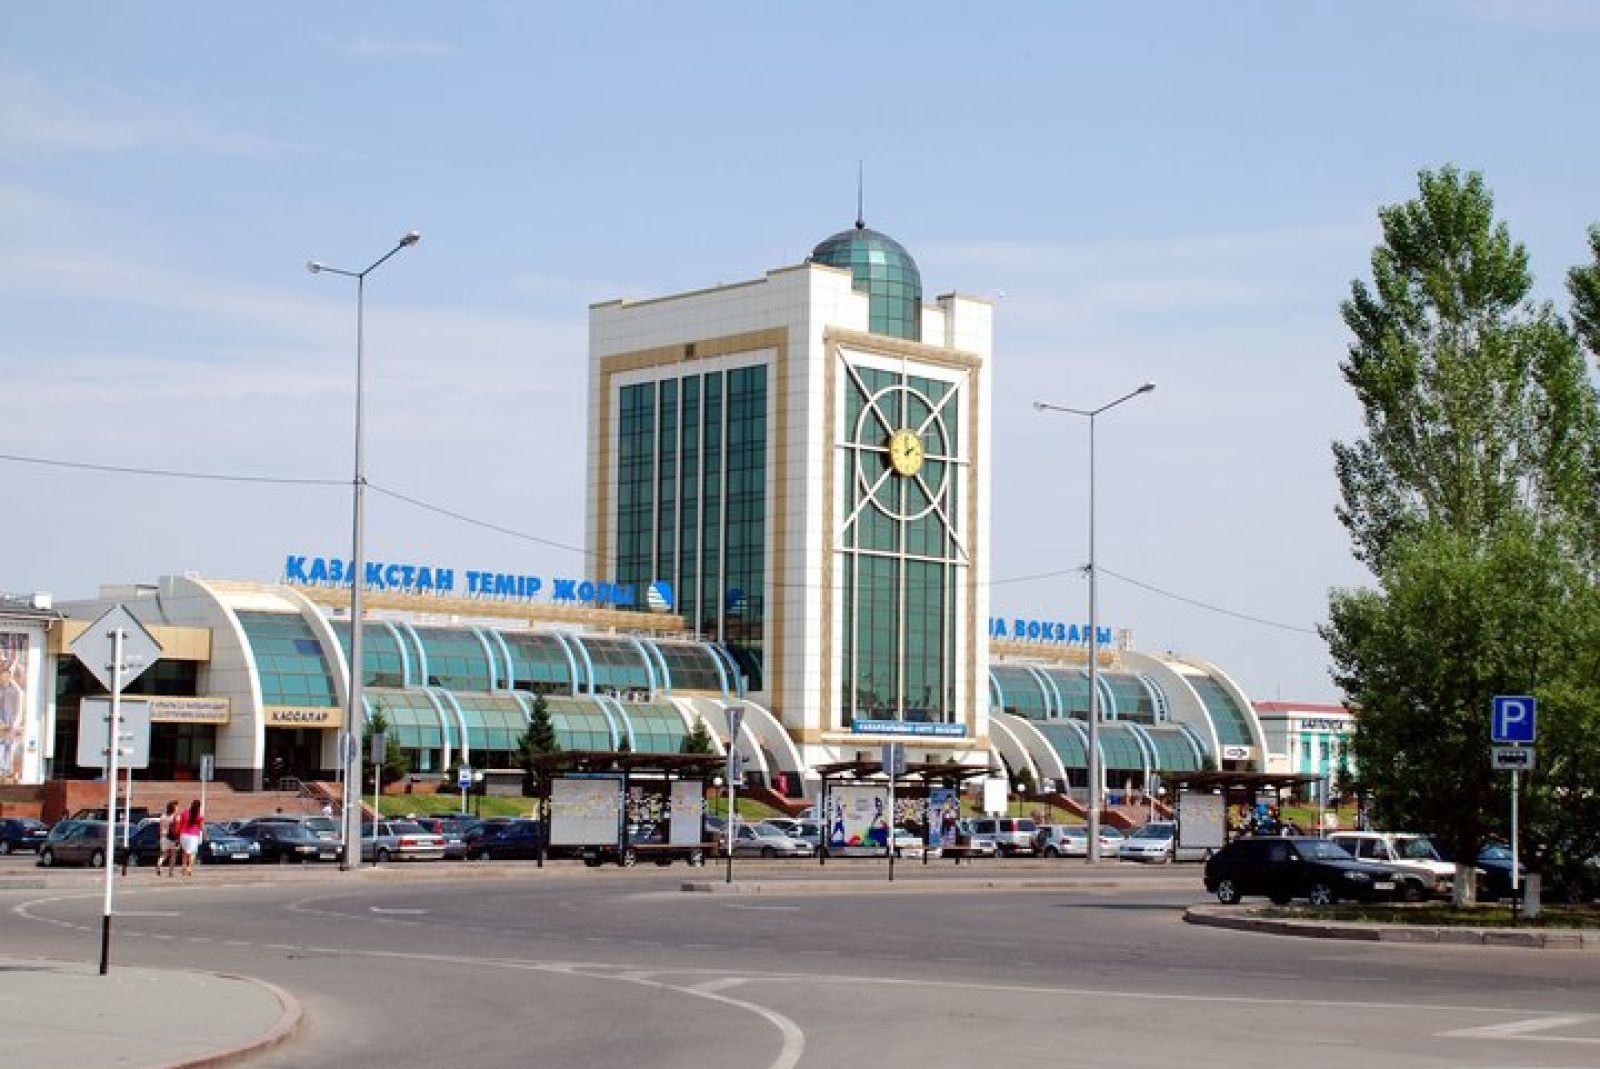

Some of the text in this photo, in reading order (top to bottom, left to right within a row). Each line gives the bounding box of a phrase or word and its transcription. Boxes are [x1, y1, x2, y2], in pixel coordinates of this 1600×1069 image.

[466, 570, 542, 597] ТЕМІР
[553, 578, 635, 606] ЖОЛЫ
[1501, 701, 1526, 737] P
